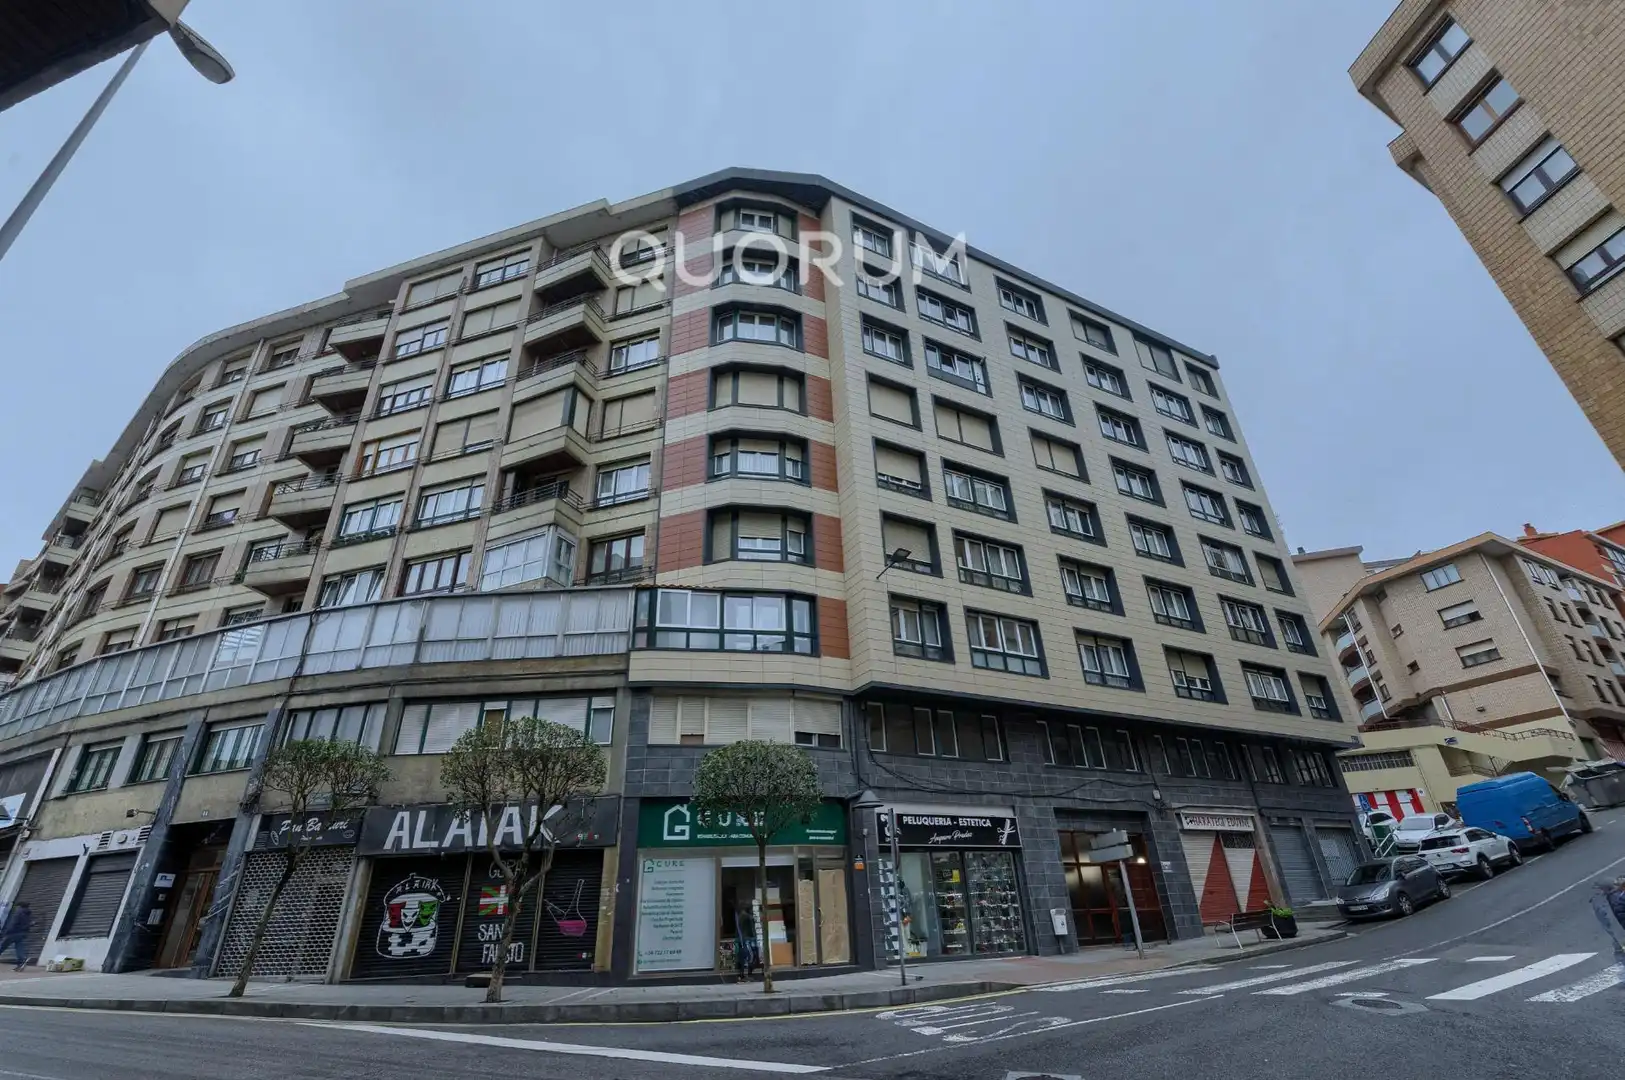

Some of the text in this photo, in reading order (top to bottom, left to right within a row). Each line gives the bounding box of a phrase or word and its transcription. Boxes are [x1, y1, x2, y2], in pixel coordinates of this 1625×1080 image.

[902, 816, 953, 826] PELUQUERIA
[958, 817, 992, 828] ESTETICA
[477, 923, 505, 941] SAN
